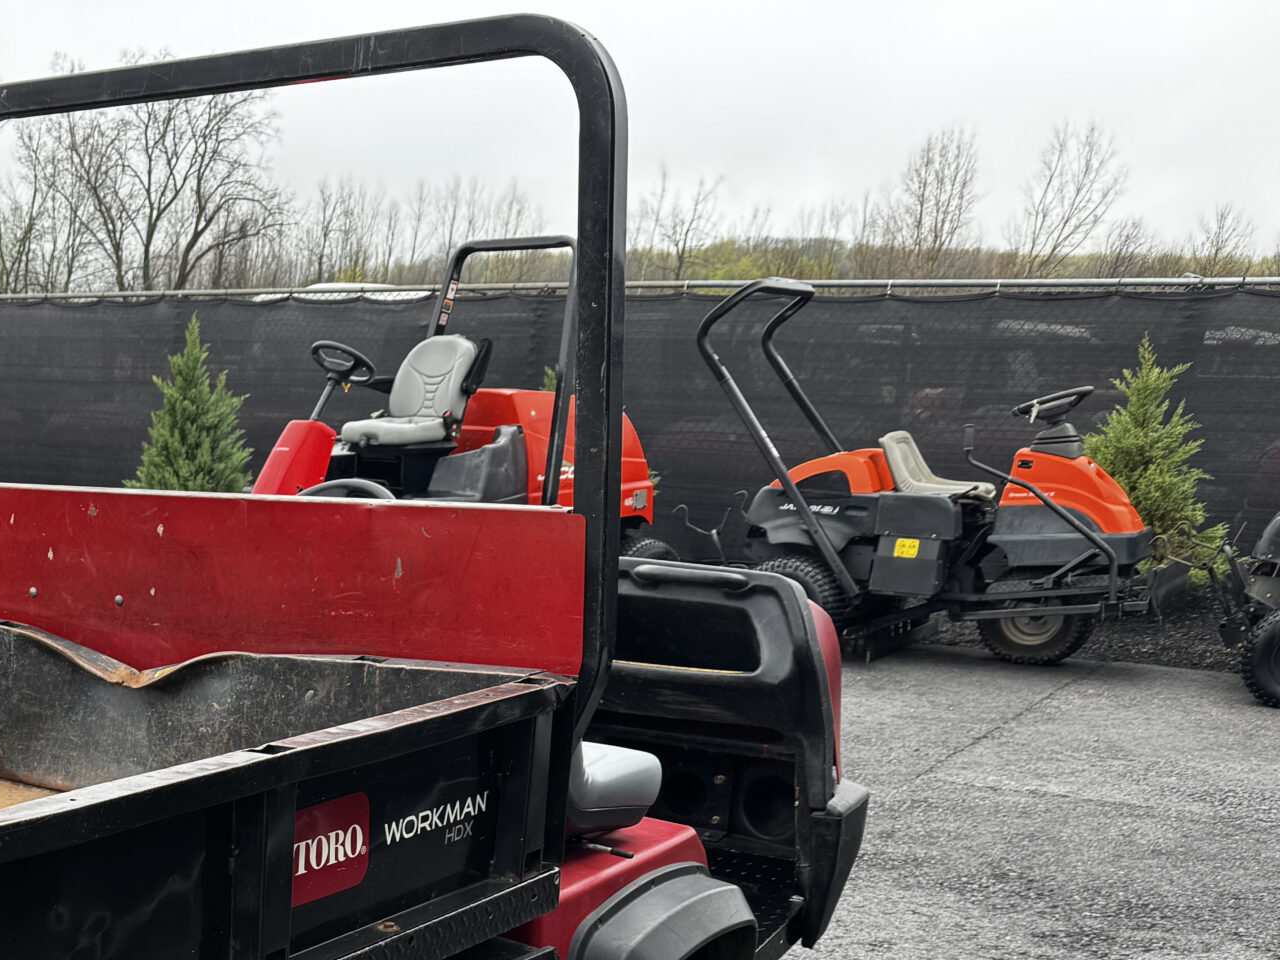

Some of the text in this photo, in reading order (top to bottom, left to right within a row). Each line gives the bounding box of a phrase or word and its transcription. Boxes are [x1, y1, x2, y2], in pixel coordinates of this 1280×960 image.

[293, 790, 489, 877] TORO WORKMAN
[444, 819, 474, 845] HDX
